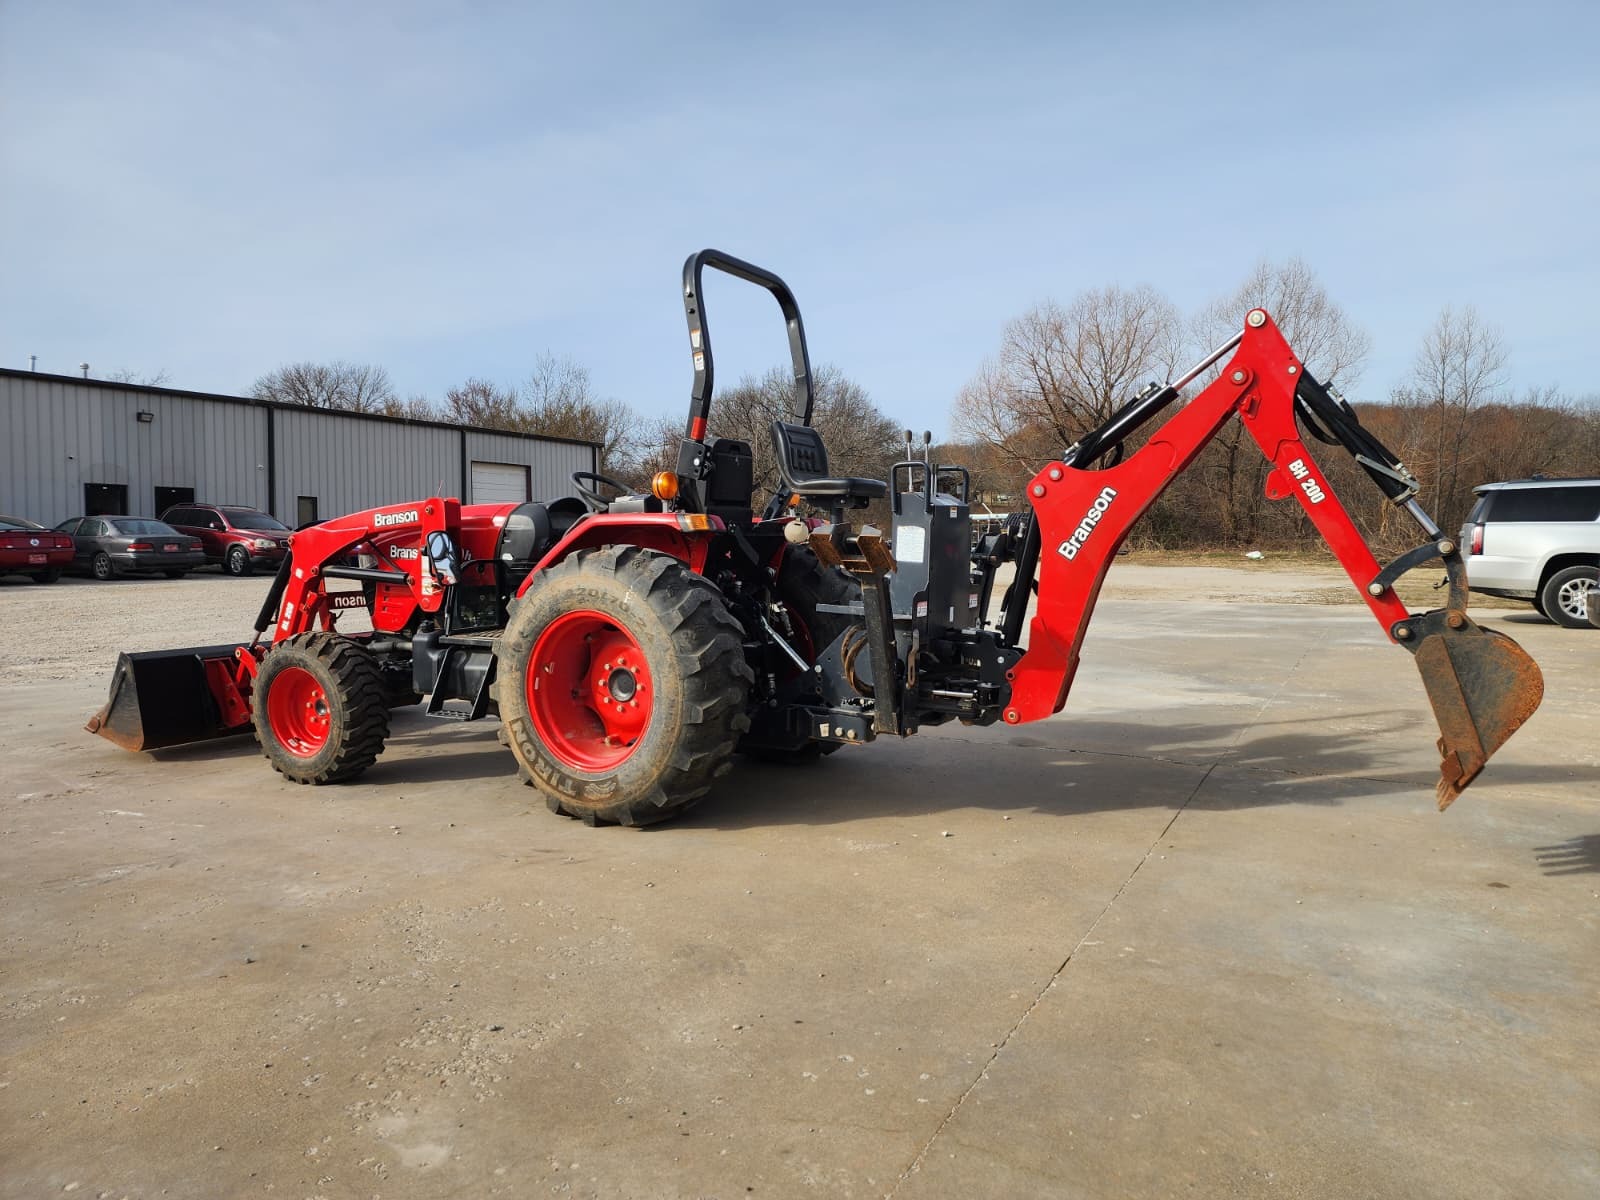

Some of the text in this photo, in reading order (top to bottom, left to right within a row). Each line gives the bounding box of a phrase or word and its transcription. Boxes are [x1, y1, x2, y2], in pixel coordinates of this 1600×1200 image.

[1288, 458, 1326, 504] BH 200
[374, 510, 418, 527] Branson
[1057, 486, 1118, 561] Branson
[390, 545, 418, 559] Brans
